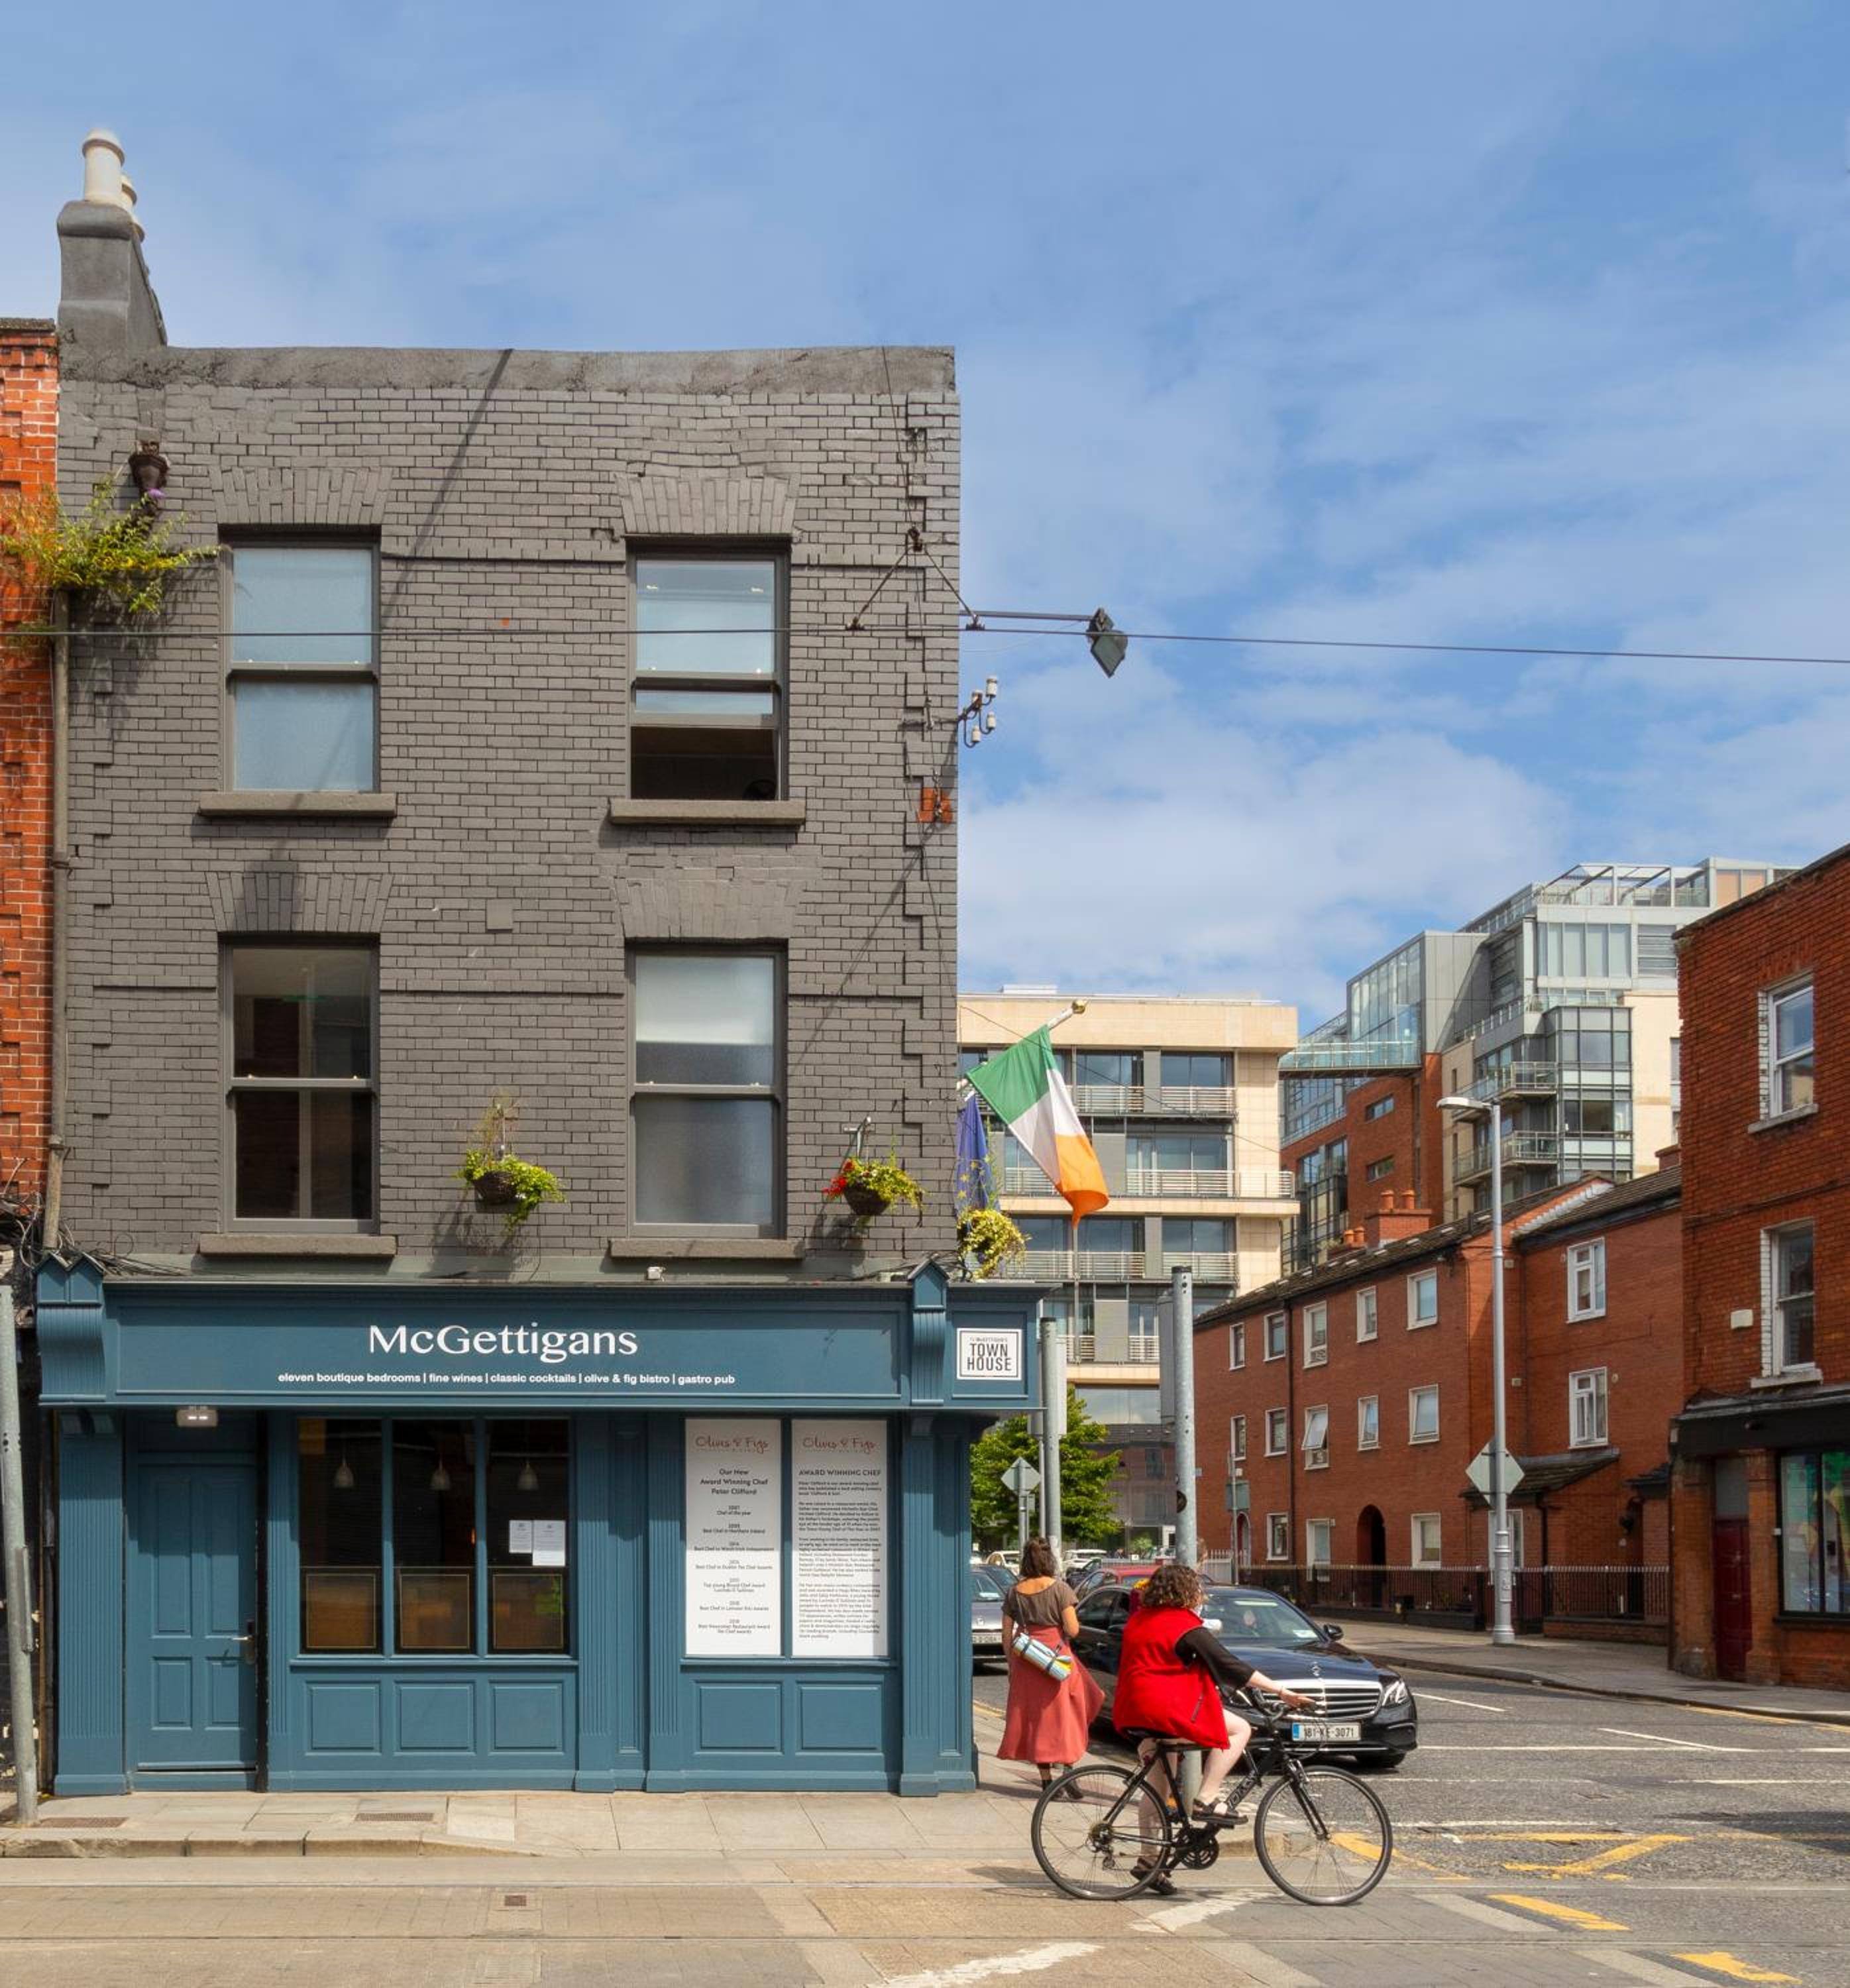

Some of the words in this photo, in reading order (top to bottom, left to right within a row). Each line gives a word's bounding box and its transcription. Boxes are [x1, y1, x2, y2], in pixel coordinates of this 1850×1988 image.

[369, 1322, 638, 1363] McGettigans
[969, 1343, 1007, 1357] TOWN
[967, 1357, 1012, 1371] HOUSE
[278, 1372, 314, 1382] eleven
[316, 1372, 364, 1386] boutique
[366, 1372, 421, 1383] bedrooms
[429, 1372, 451, 1383] fine
[454, 1373, 483, 1384] wines
[490, 1373, 526, 1384] classic
[529, 1373, 576, 1384] cocktails
[584, 1373, 610, 1384] olive
[612, 1374, 622, 1384] &
[624, 1373, 637, 1386] fig
[639, 1374, 670, 1384] bistro
[678, 1375, 712, 1386] gastro
[714, 1374, 735, 1386] pub
